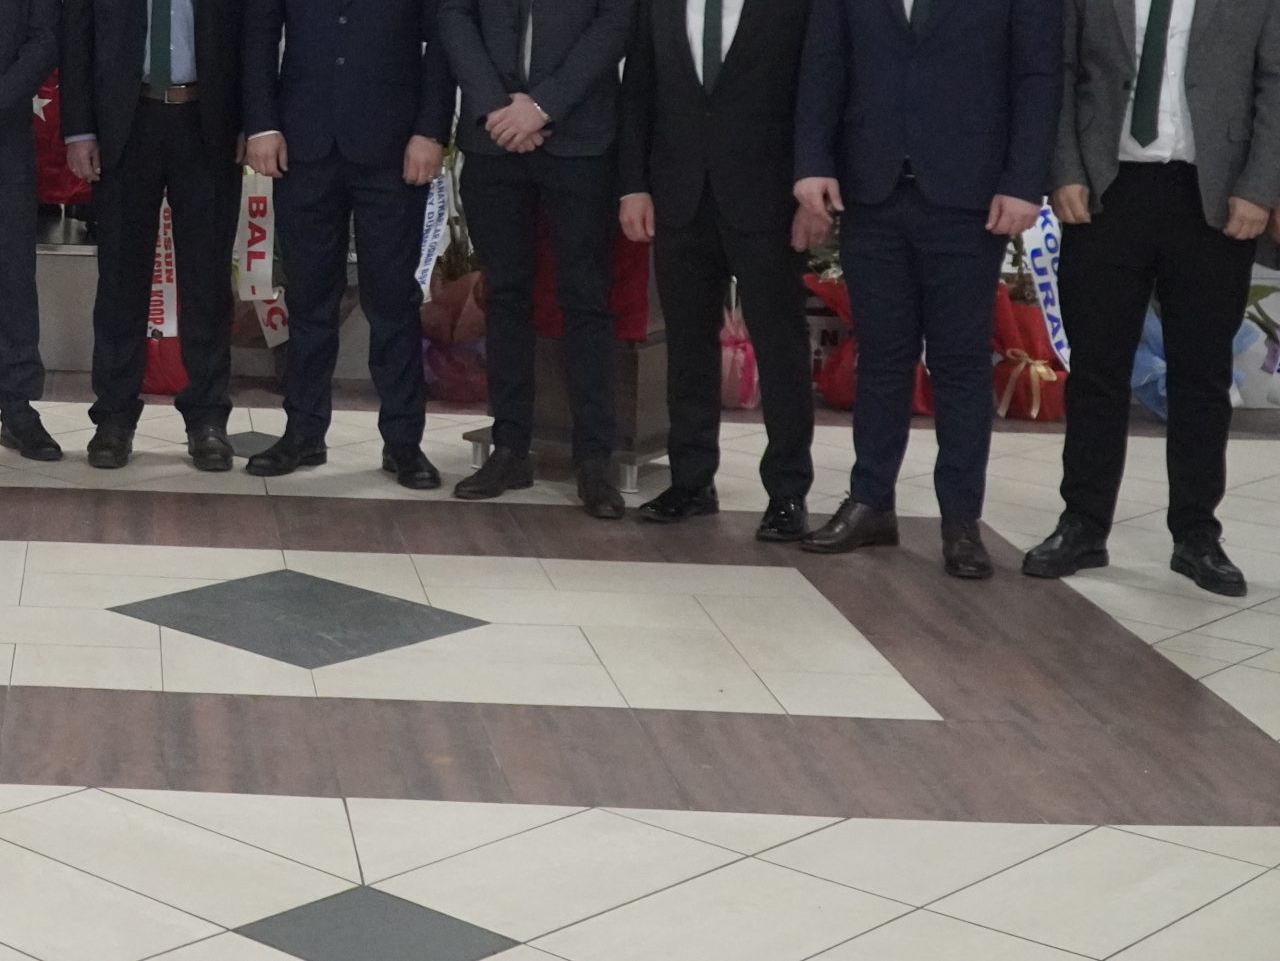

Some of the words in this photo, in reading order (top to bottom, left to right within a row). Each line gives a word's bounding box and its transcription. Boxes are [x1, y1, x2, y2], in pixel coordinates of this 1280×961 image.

[163, 208, 173, 283] OLSUN
[246, 196, 268, 271] BAL
[1031, 248, 1068, 364] URAL
